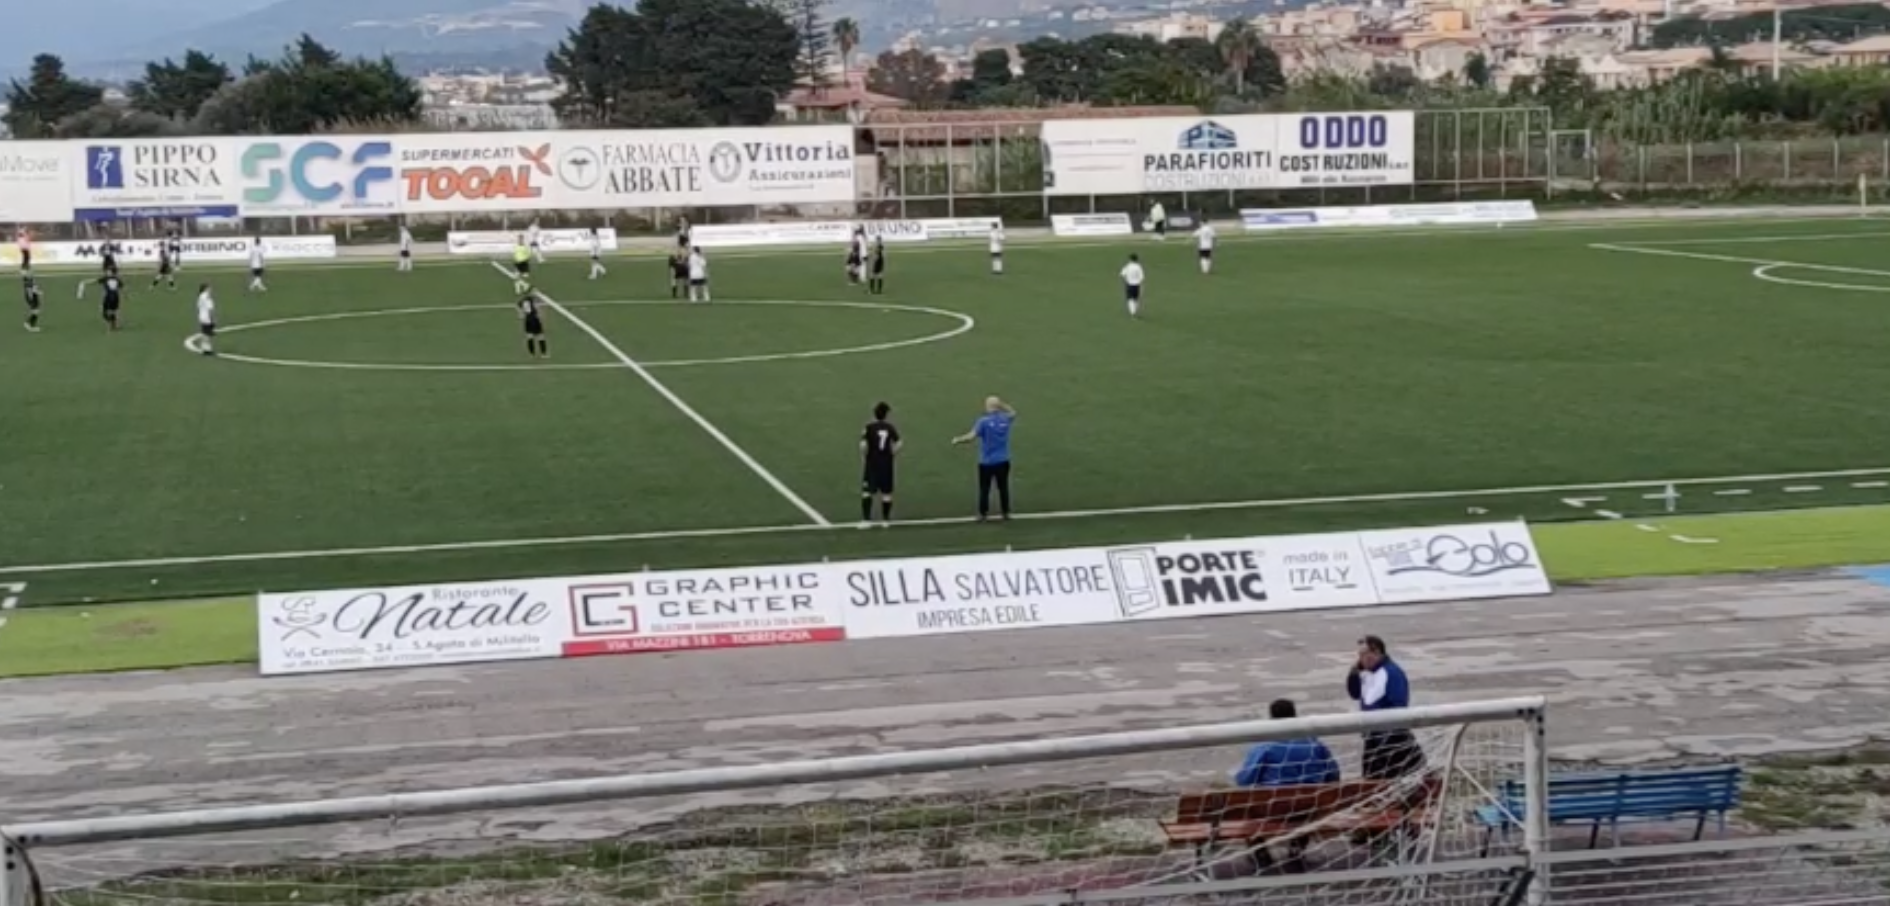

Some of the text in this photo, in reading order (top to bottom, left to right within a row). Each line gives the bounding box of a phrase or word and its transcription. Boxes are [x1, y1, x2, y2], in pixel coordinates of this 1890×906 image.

[1300, 115, 1387, 149] ODDO
[134, 144, 217, 165] PIPPO
[401, 147, 514, 161] SUPERMERCATI
[603, 142, 701, 166] FARMACIA
[743, 141, 851, 162] Vittoria
[1144, 151, 1272, 172] PARAFIORITI
[242, 141, 393, 203] SCF
[1280, 153, 1388, 172] COSTRUZIONI
[135, 167, 221, 188] SIRNA
[604, 165, 702, 194] ABBATE
[1144, 173, 1247, 191] COSTRUZIONI
[877, 430, 889, 451] 7
[1157, 550, 1258, 575] PORTE
[1283, 551, 1329, 565] made
[646, 572, 819, 596] GRAPHIC
[847, 564, 1110, 607] SILLA SALVATORE
[1288, 567, 1350, 585] ITALY
[432, 585, 518, 602] Ristorante
[1162, 575, 1267, 606] IMIC
[334, 591, 551, 640] Natale
[659, 595, 813, 618] CENTER
[917, 604, 1040, 629] IMPRESA EDILE
[283, 646, 305, 659] Via
